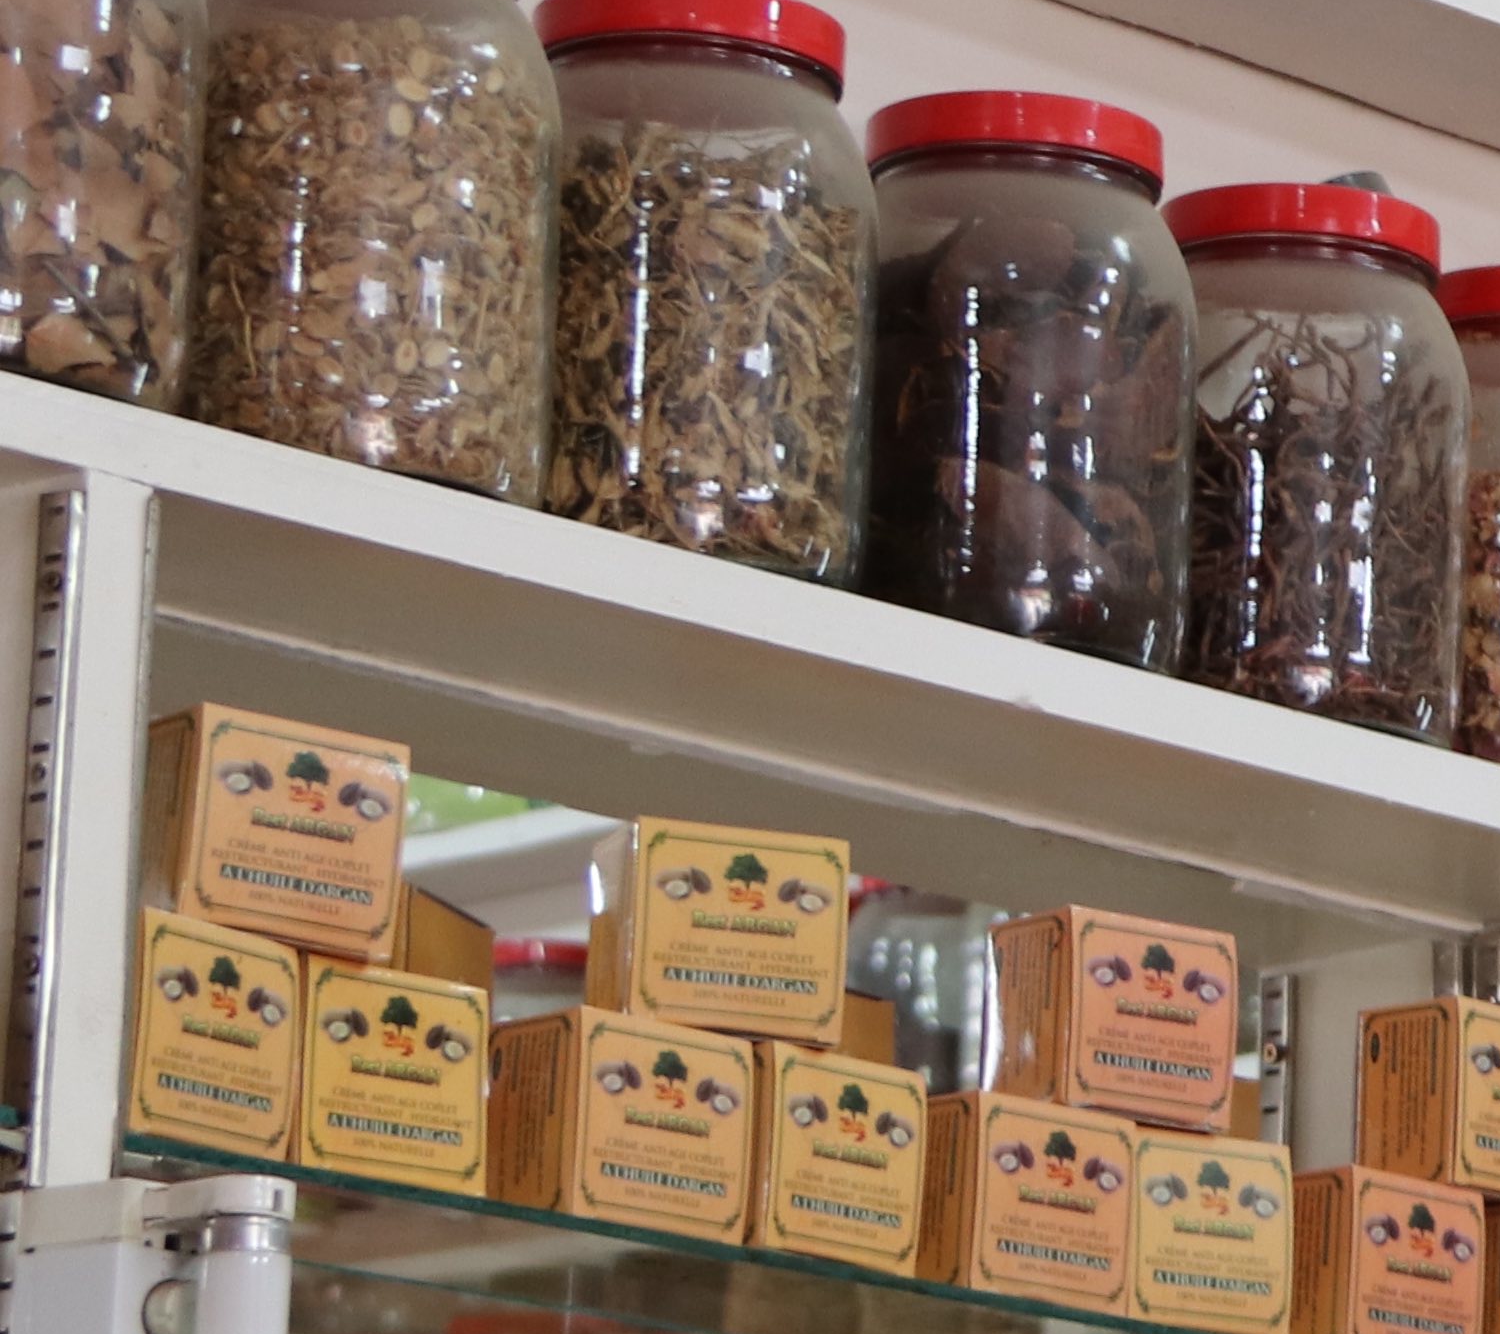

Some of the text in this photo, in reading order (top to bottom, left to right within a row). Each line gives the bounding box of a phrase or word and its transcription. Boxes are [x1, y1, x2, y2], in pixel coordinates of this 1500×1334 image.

[250, 807, 356, 843] Best ARGAN
[691, 910, 798, 937] Best ARGAN
